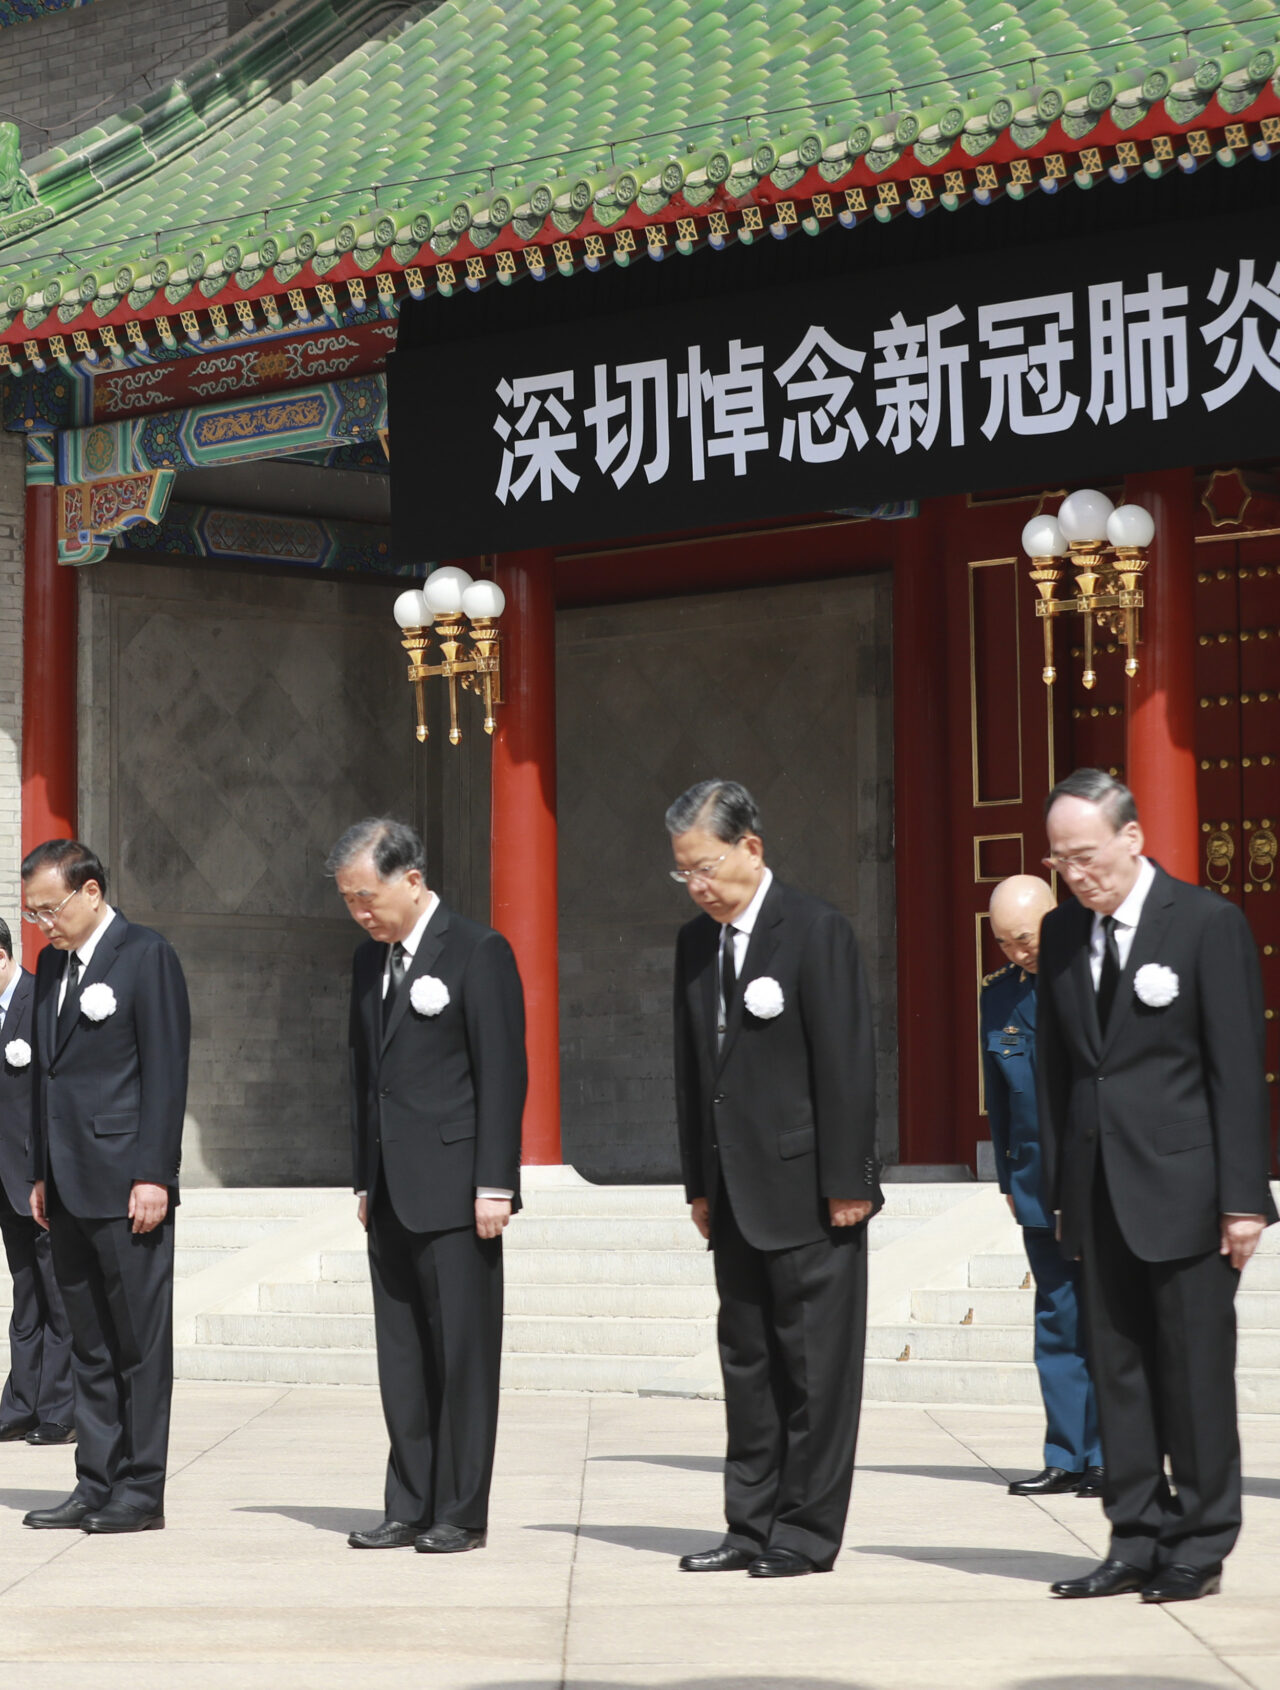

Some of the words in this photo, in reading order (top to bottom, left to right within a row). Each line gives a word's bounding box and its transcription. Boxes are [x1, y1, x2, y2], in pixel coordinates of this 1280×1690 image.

[493, 259, 1280, 506] 深切悼念新冠肺炎
